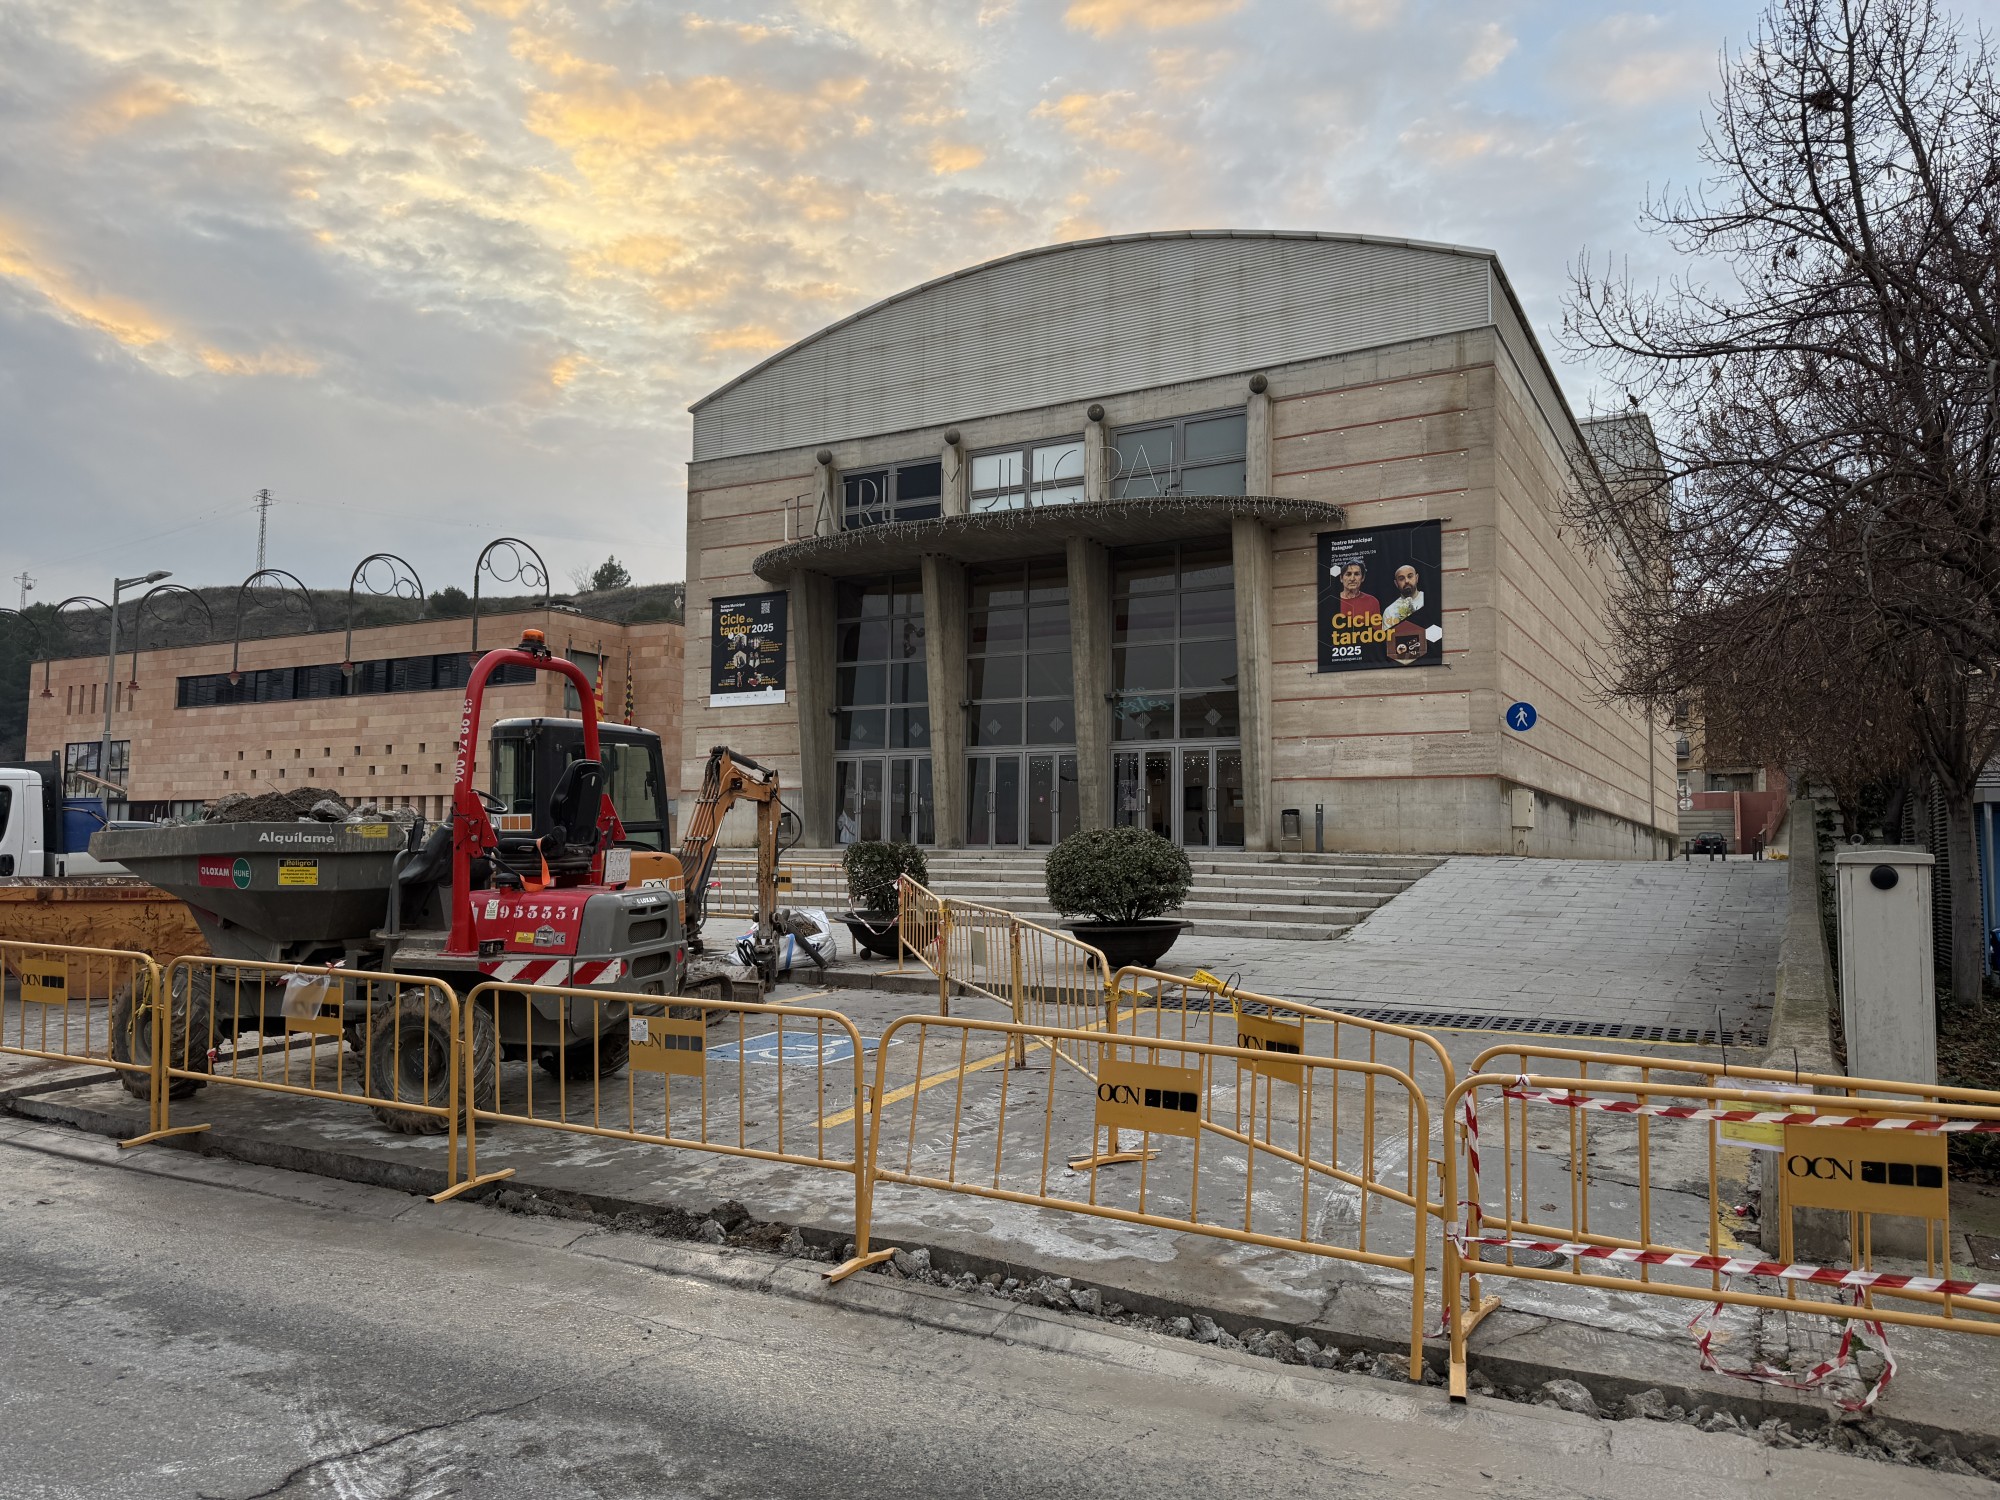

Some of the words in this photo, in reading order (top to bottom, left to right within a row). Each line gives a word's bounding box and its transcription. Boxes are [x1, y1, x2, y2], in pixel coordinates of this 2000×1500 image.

[781, 473, 902, 543] TEATRE
[941, 441, 1195, 516] MUNICIPAL
[720, 613, 746, 626] Cicle
[1332, 610, 1382, 630] Cicle
[1386, 616, 1400, 624] de
[720, 624, 752, 636] tardor
[752, 622, 774, 634] 2025
[1332, 627, 1396, 646] tardor
[1332, 646, 1362, 656] 2025
[454, 759, 466, 784] 900
[258, 832, 335, 844] Alquílame
[206, 867, 230, 876] LOXAM
[234, 870, 250, 878] HUNE
[500, 905, 578, 920] 953331
[22, 974, 40, 986] OCN
[1238, 1033, 1264, 1050] OCN
[1098, 1083, 1141, 1105] OCN
[1787, 1155, 1853, 1181] OCN
